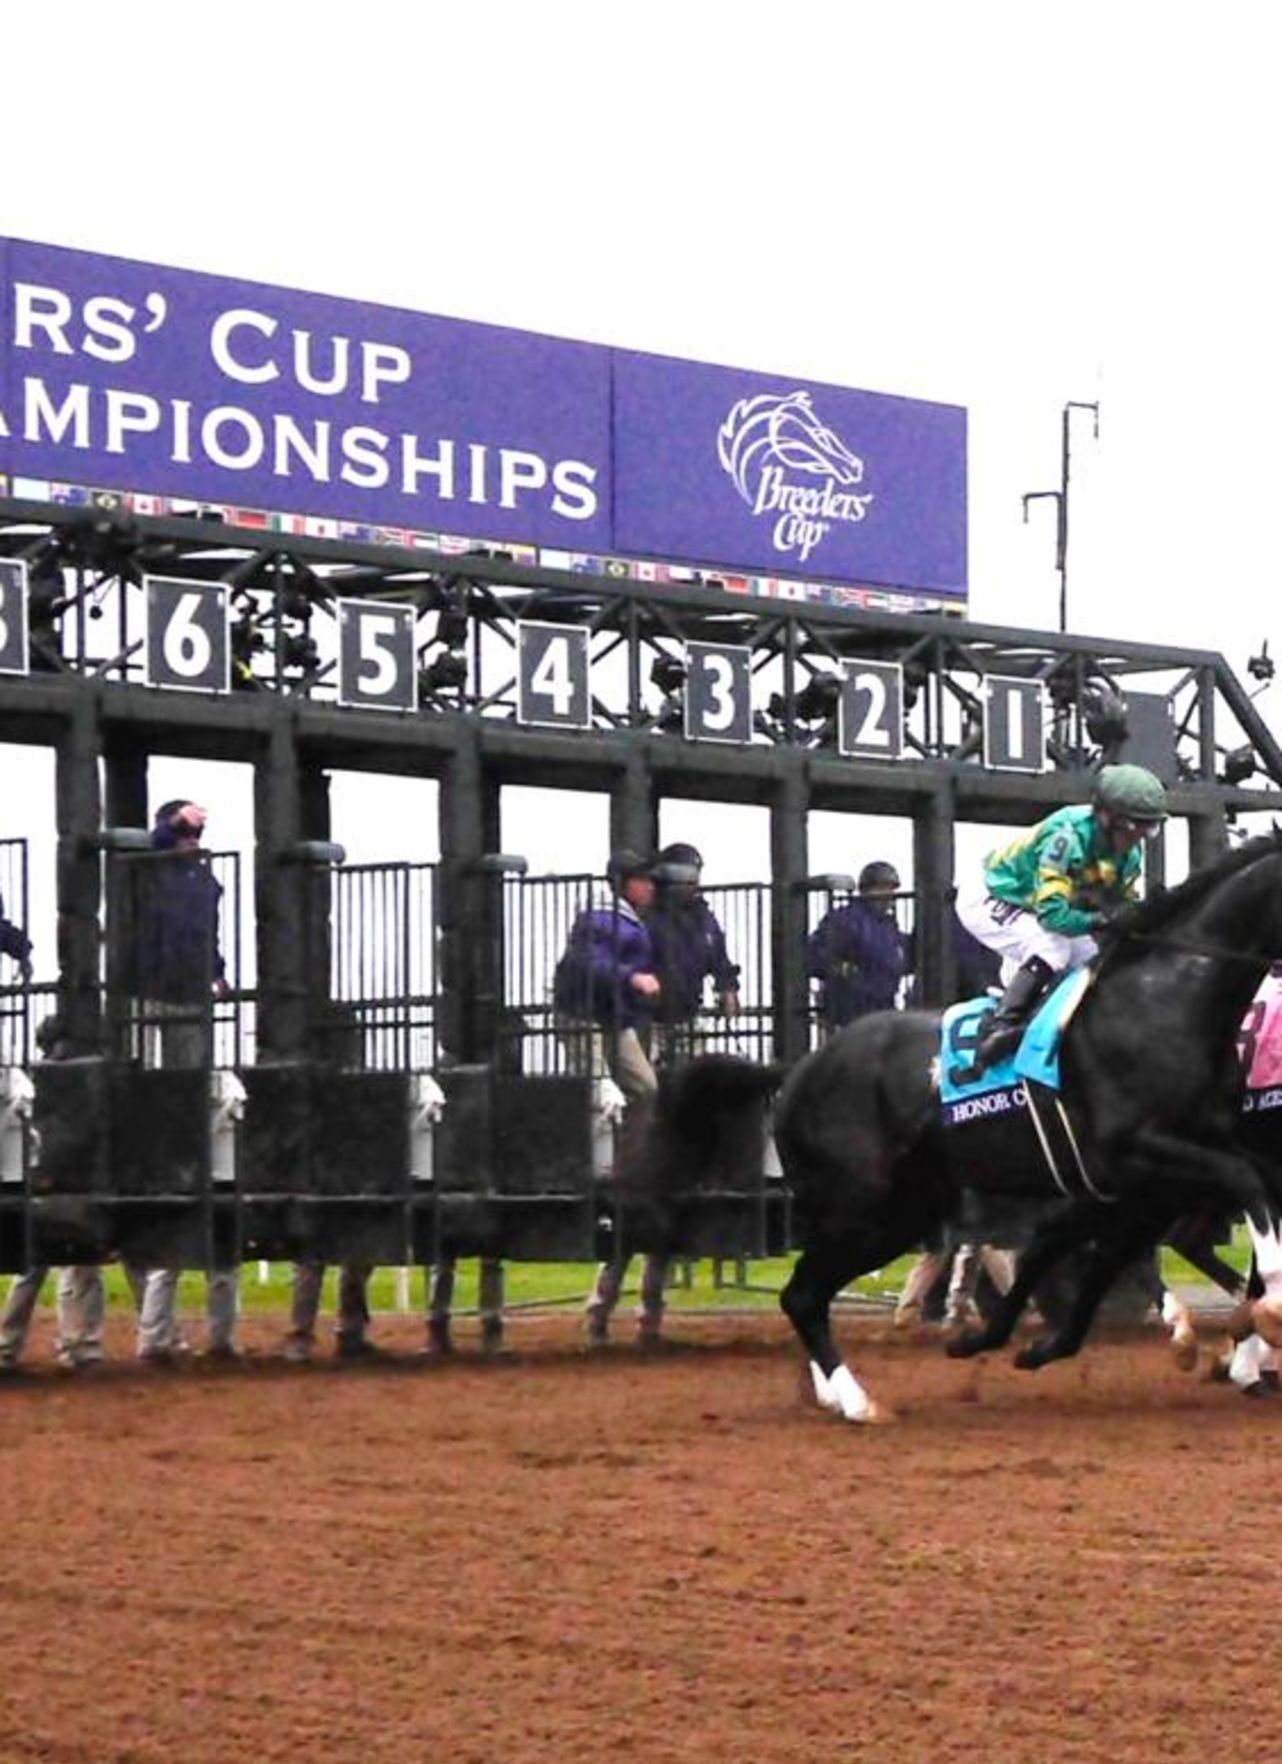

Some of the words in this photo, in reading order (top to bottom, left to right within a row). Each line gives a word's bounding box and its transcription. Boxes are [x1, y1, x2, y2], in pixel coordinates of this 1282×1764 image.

[209, 308, 412, 404] CUP
[0, 376, 598, 520] MPIONSHIPS
[773, 512, 831, 562] Cup
[163, 592, 211, 678] 6
[358, 614, 398, 696] 5
[531, 637, 574, 716] 4
[702, 654, 735, 731] 3
[854, 672, 890, 748] 2
[1007, 689, 1023, 760] 1
[1048, 836, 1069, 862] 9
[951, 1092, 1011, 1123] HONOR
